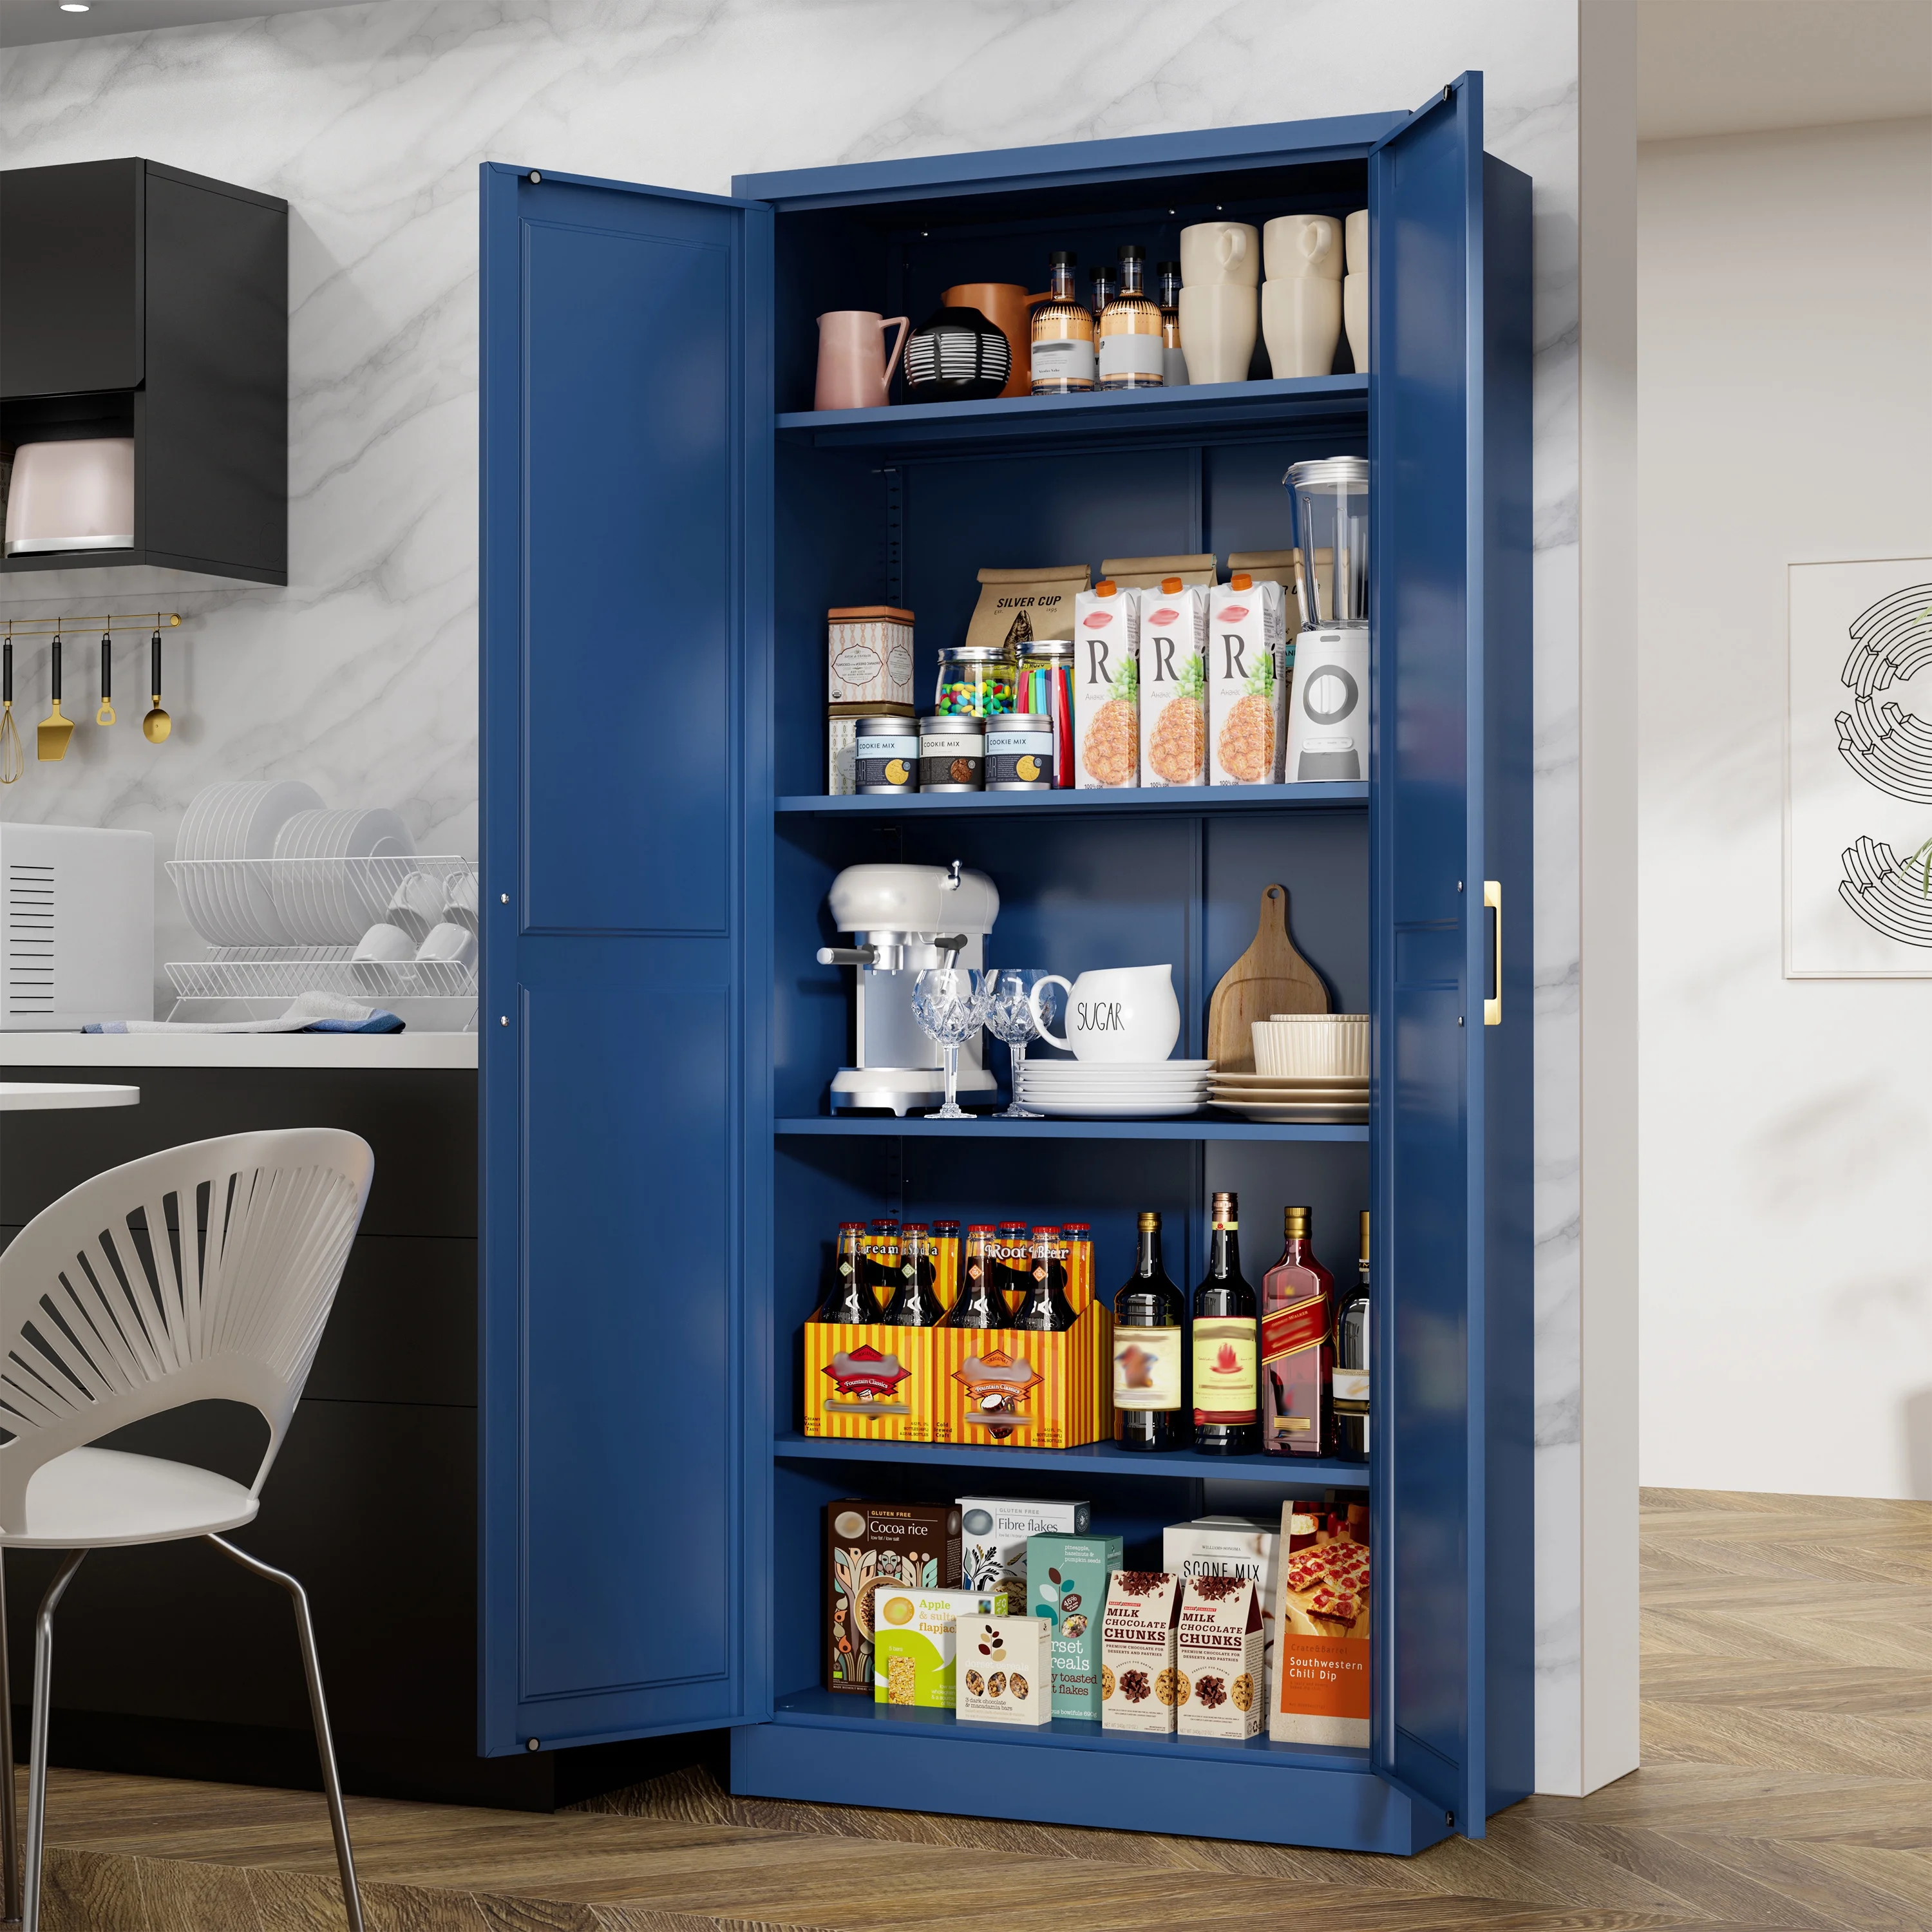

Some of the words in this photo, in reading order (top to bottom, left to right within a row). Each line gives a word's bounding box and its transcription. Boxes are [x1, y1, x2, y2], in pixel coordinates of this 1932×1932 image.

[997, 597, 1035, 607] SILVER
[1037, 596, 1062, 606] CUP
[1077, 1002, 1125, 1030] SUGAR
[844, 1379, 868, 1387] Fountain
[869, 1379, 888, 1388] Classics
[974, 1384, 999, 1392] Fountain
[999, 1384, 1020, 1394] Classics
[870, 1520, 905, 1534] Cocoa
[908, 1523, 928, 1535] rice
[999, 1517, 1025, 1531] Fibre
[1028, 1519, 1058, 1533] flakes
[1235, 1564, 1260, 1582] MIX
[919, 1599, 951, 1611] Apple
[1063, 1595, 1077, 1607] 45%
[919, 1611, 927, 1620] &
[1106, 1608, 1140, 1618] MILK
[1182, 1613, 1215, 1622] MILK
[919, 1622, 956, 1634] flapjac
[1105, 1618, 1166, 1629] CHOCOLATE
[1180, 1624, 1243, 1634] CHOCOLATE
[1104, 1628, 1166, 1641] CHUNKS
[1180, 1633, 1242, 1647] CHUNKS
[1291, 1643, 1347, 1654] Crate&Barrel
[965, 1659, 994, 1669] dorset
[996, 1662, 1029, 1671] cereals
[1290, 1656, 1363, 1671] Southwestern
[1060, 1672, 1097, 1684] toasted
[1289, 1669, 1314, 1679] Chili
[1320, 1671, 1336, 1682] Dip
[1059, 1684, 1089, 1696] flakes
